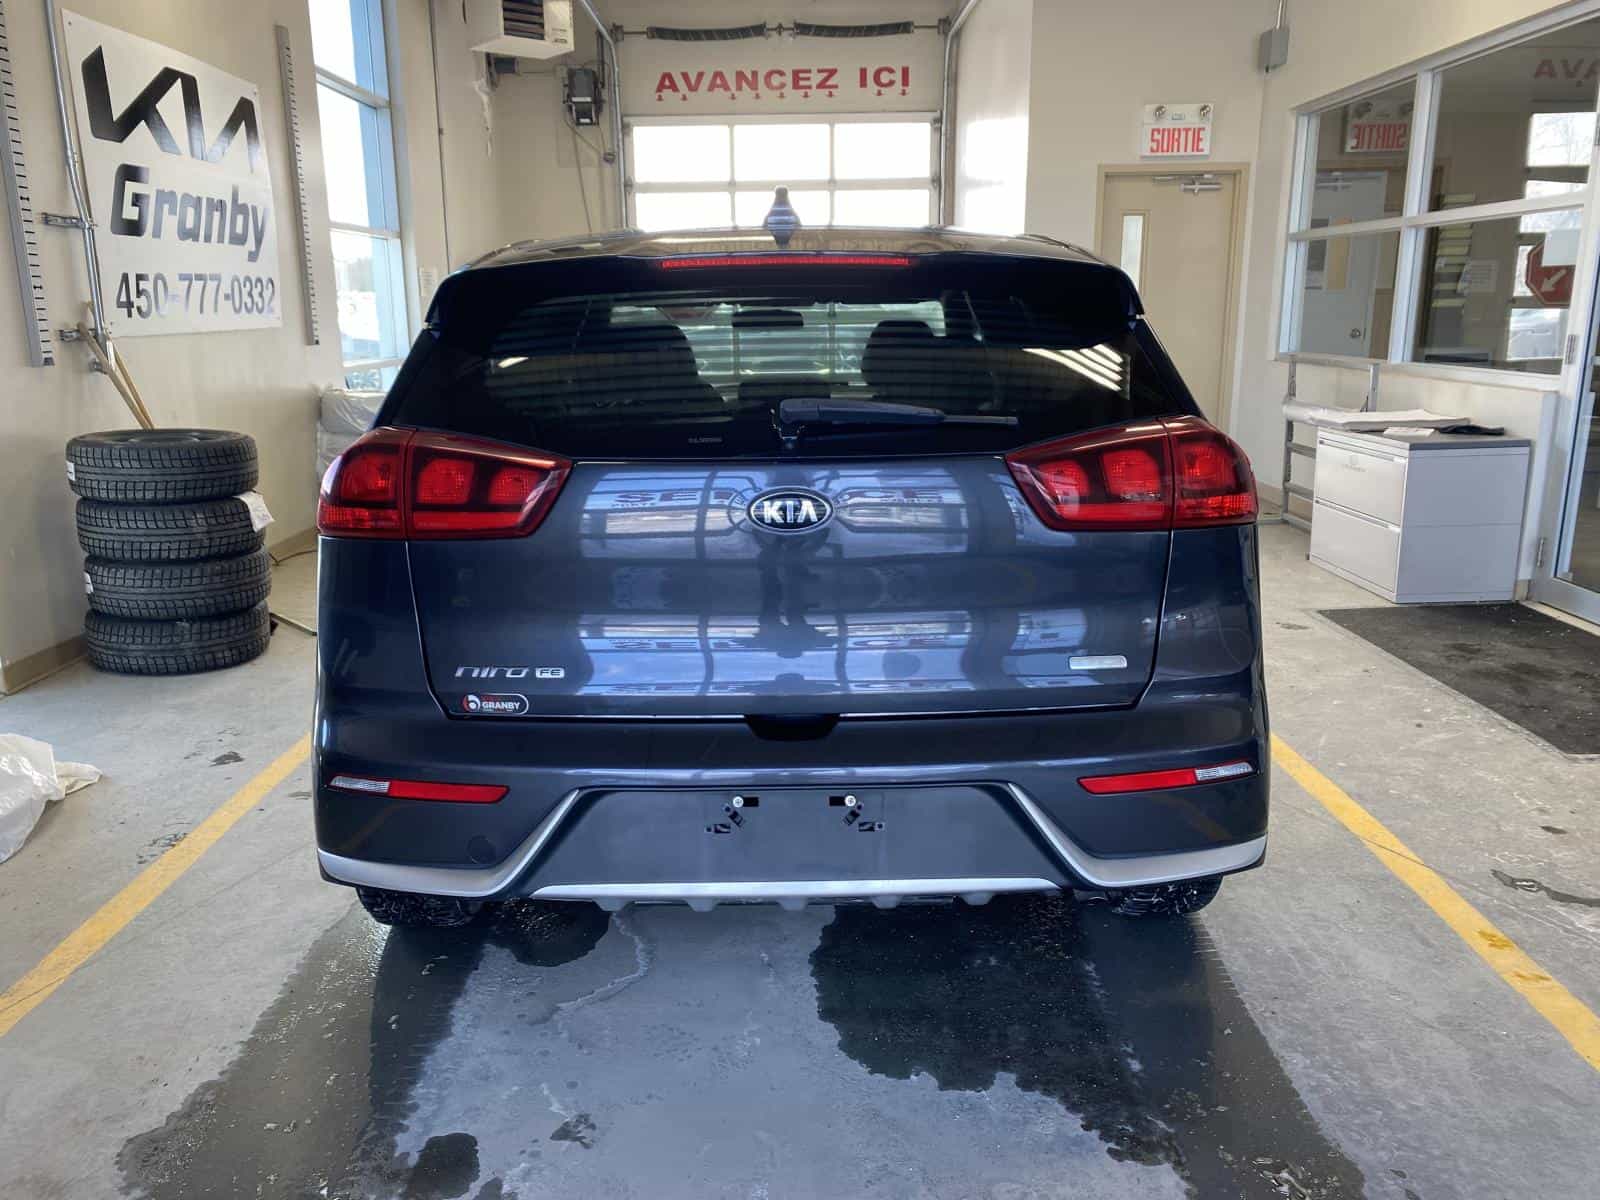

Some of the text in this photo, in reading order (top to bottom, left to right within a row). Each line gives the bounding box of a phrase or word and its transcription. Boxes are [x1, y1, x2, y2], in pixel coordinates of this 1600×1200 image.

[655, 68, 839, 94] AVANCEZ
[81, 45, 259, 174] KIA
[1150, 127, 1206, 153] SORTIE
[110, 163, 267, 262] Granby
[115, 271, 276, 319] 450-777-0332
[763, 500, 819, 523] KIA
[482, 701, 520, 710] GRANBY
